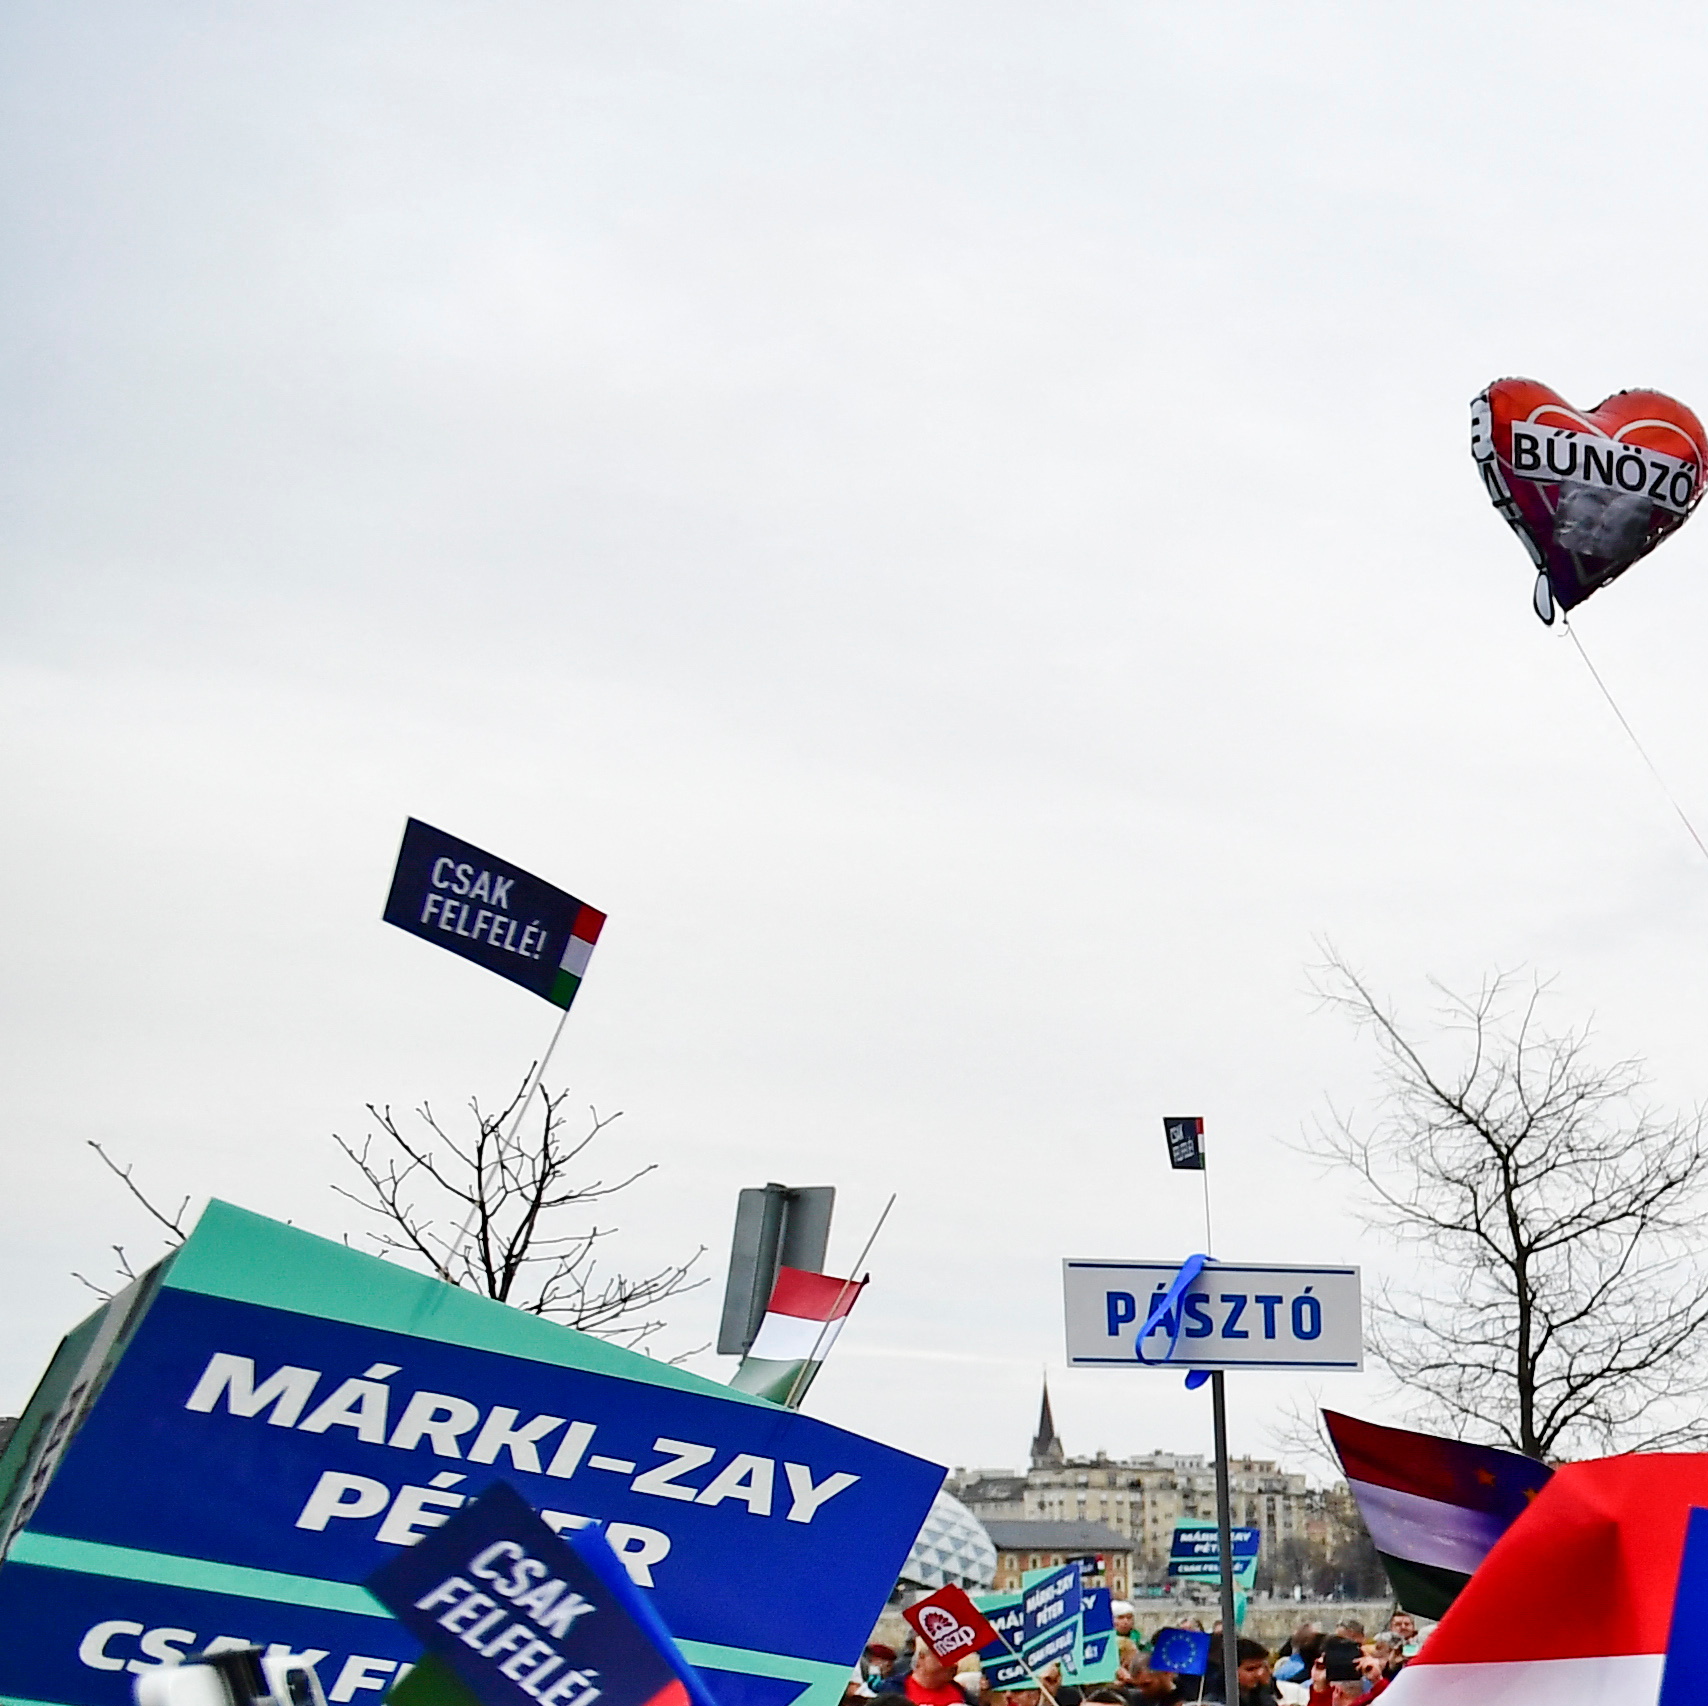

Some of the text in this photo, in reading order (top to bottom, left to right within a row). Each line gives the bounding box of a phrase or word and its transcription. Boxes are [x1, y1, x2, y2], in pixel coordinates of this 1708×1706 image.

[1512, 430, 1695, 508] BŰNÖZŐ
[431, 856, 515, 910] CSAK
[420, 892, 548, 960] FELFELÉ!
[1106, 1282, 1323, 1341] PÁSZTÓ
[184, 1352, 862, 1524] MÁRKI-ZAY
[294, 1470, 671, 1589] PÉR
[467, 1539, 598, 1640] CSAK
